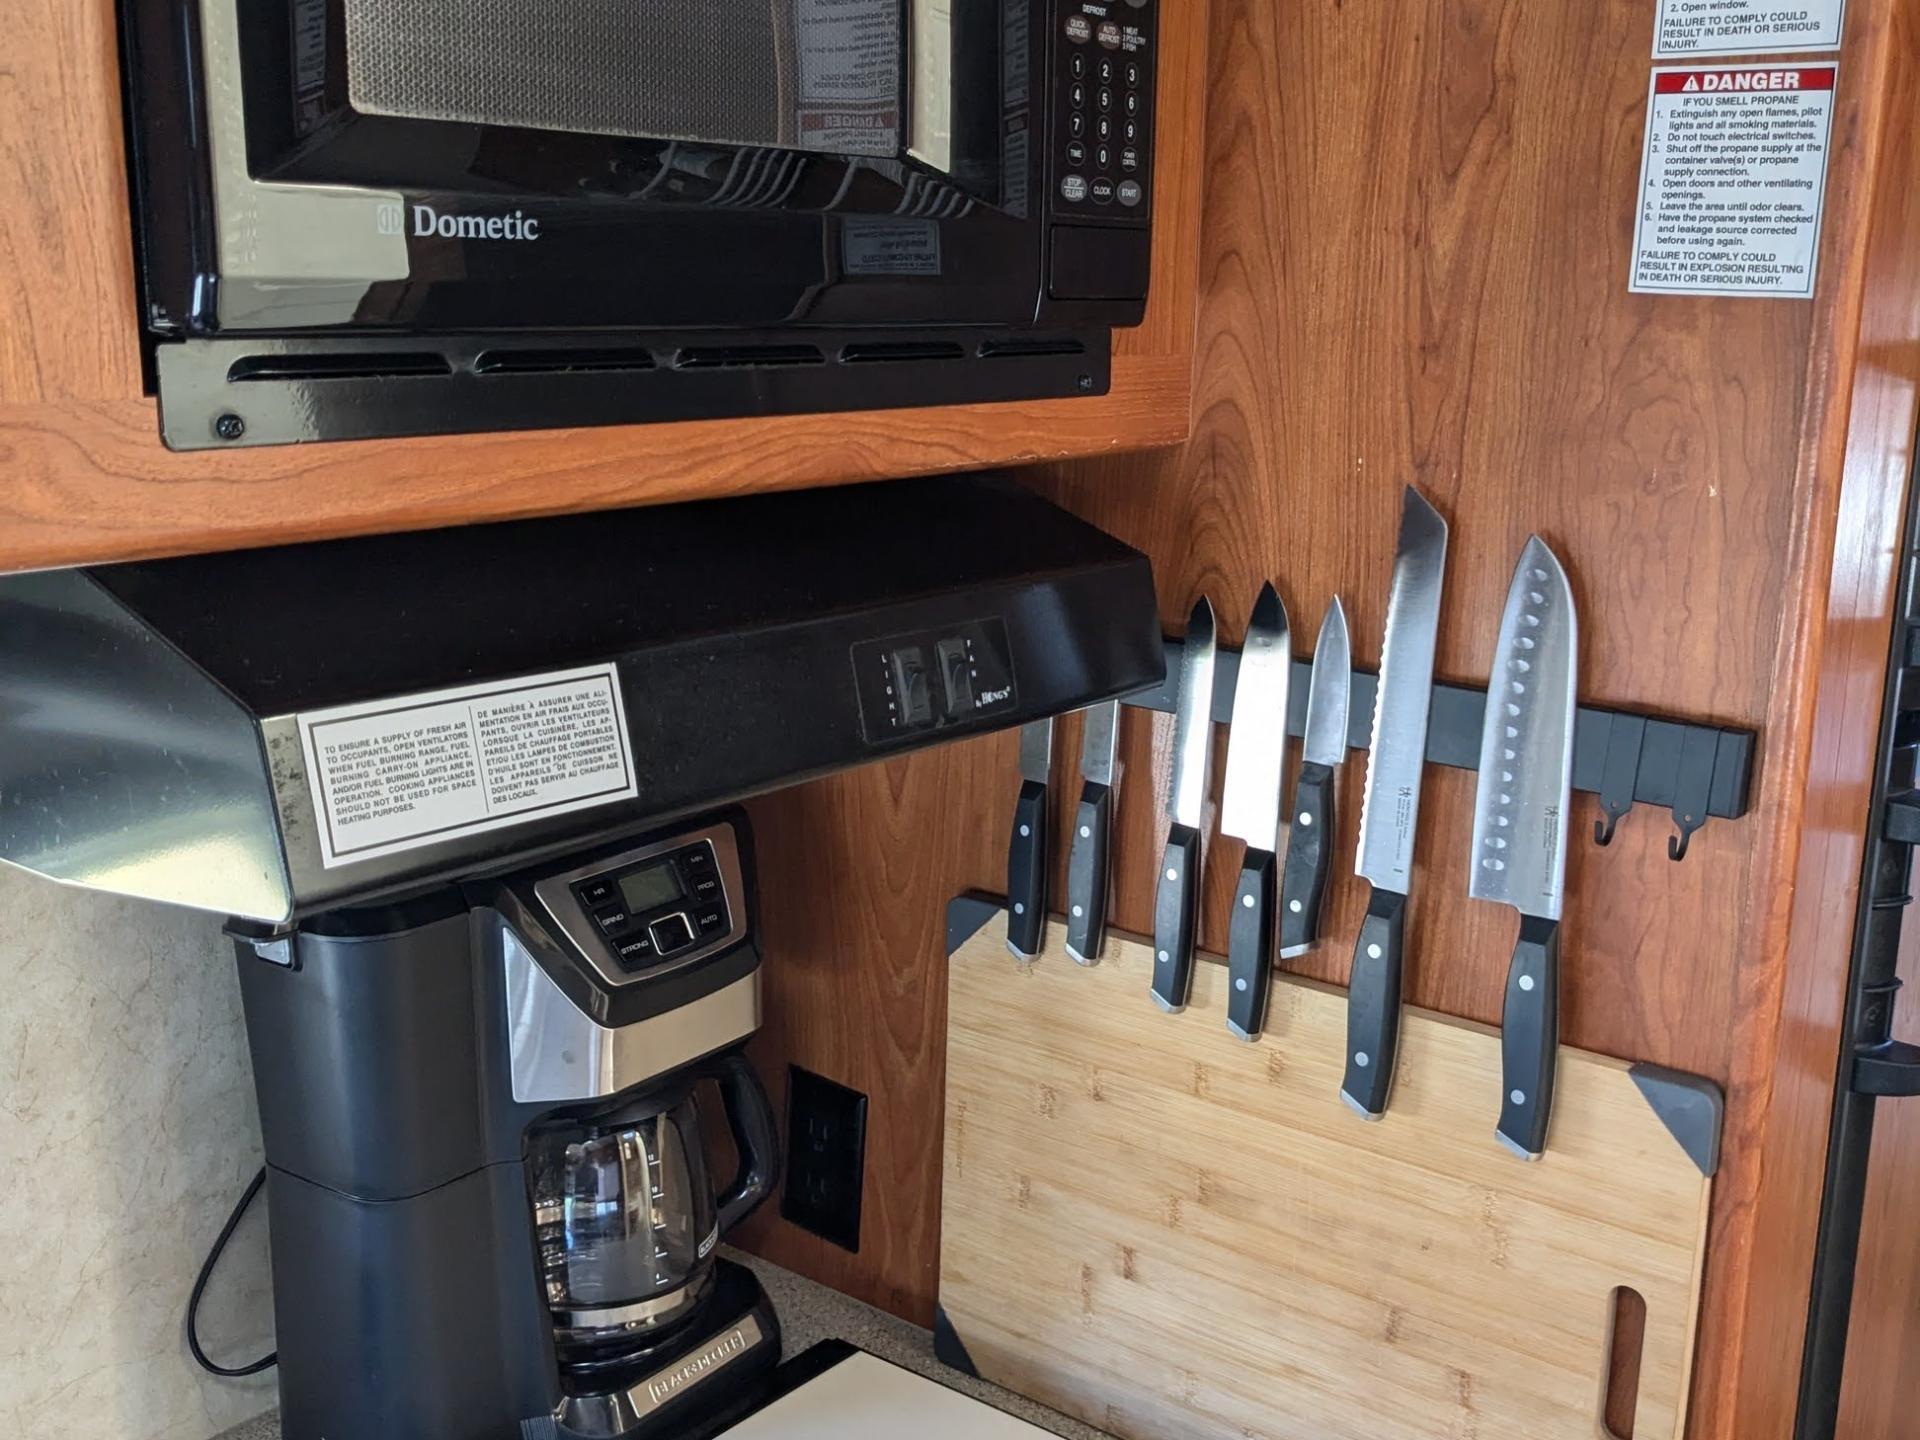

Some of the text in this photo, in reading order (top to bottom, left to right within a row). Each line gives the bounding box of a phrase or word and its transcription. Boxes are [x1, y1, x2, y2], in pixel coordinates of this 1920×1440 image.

[1670, 0, 1749, 13] 2. Open window.
[1663, 11, 1808, 28] FAILURE TO COMPLY COULD
[1662, 21, 1821, 39] RESULT IN DEATH OR SERIOUS
[1661, 39, 1699, 49] INJURY.
[1702, 71, 1800, 91] DANGER
[1683, 95, 1800, 107] IF YOU SMELL PROPANE
[1656, 107, 1823, 119] 1. Extinguish any open flames, pilot
[1669, 119, 1817, 131] lights and all smoking materials.
[1652, 131, 1816, 142] 2. Do not touch electrical switches.
[1651, 143, 1822, 154] 3. Shut off the propane supply at the
[1664, 155, 1708, 165] container
[1709, 155, 1746, 166] valve(s)
[1759, 156, 1799, 166] propane
[1663, 167, 1750, 177] supply connection.
[1067, 178, 1081, 186] STOP
[1648, 178, 1813, 190] 4. Open doors and other ventilating
[1093, 186, 1111, 195] CLOCK
[1121, 188, 1137, 198] START
[1661, 190, 1706, 200] openings.
[1646, 201, 1805, 212] 5. Leave the area until odor clears.
[413, 206, 540, 240] Dometic
[1644, 212, 1814, 224] 6. Have the propane system checked
[1657, 224, 1798, 235] and leakage source corrected
[1656, 235, 1745, 247] before using again.
[1640, 250, 1777, 262] FAILURE TO COMPLY COULD
[1639, 261, 1804, 274] RESULT IN EXPLOSION RESULTING
[1638, 272, 1782, 285] IN DEATH OR SERIOUS INJURY.
[510, 720, 540, 732] OUVRIR
[541, 717, 556, 727] LES
[557, 707, 610, 724] VENTILATEURS
[324, 721, 467, 754] TO ENSURE A SUPPLY OF FRESH AIR
[484, 725, 614, 757] PAREILS DE CHAUFFAGE PORTABLES
[326, 755, 338, 765] TO
[393, 741, 416, 752] OPEN
[417, 731, 469, 747] VENTILATORS
[328, 763, 354, 775] WHEN
[355, 759, 377, 770] FUEL
[379, 751, 416, 765] BURNING
[450, 741, 470, 751] FUEL
[388, 779, 426, 794] COOKING
[428, 769, 476, 786] APPLIANCES
[492, 794, 508, 805] DES
[337, 812, 372, 826] HEATING
[602, 914, 624, 927] GRIND
[701, 914, 717, 925] AUTO
[621, 939, 649, 955] STRONG
